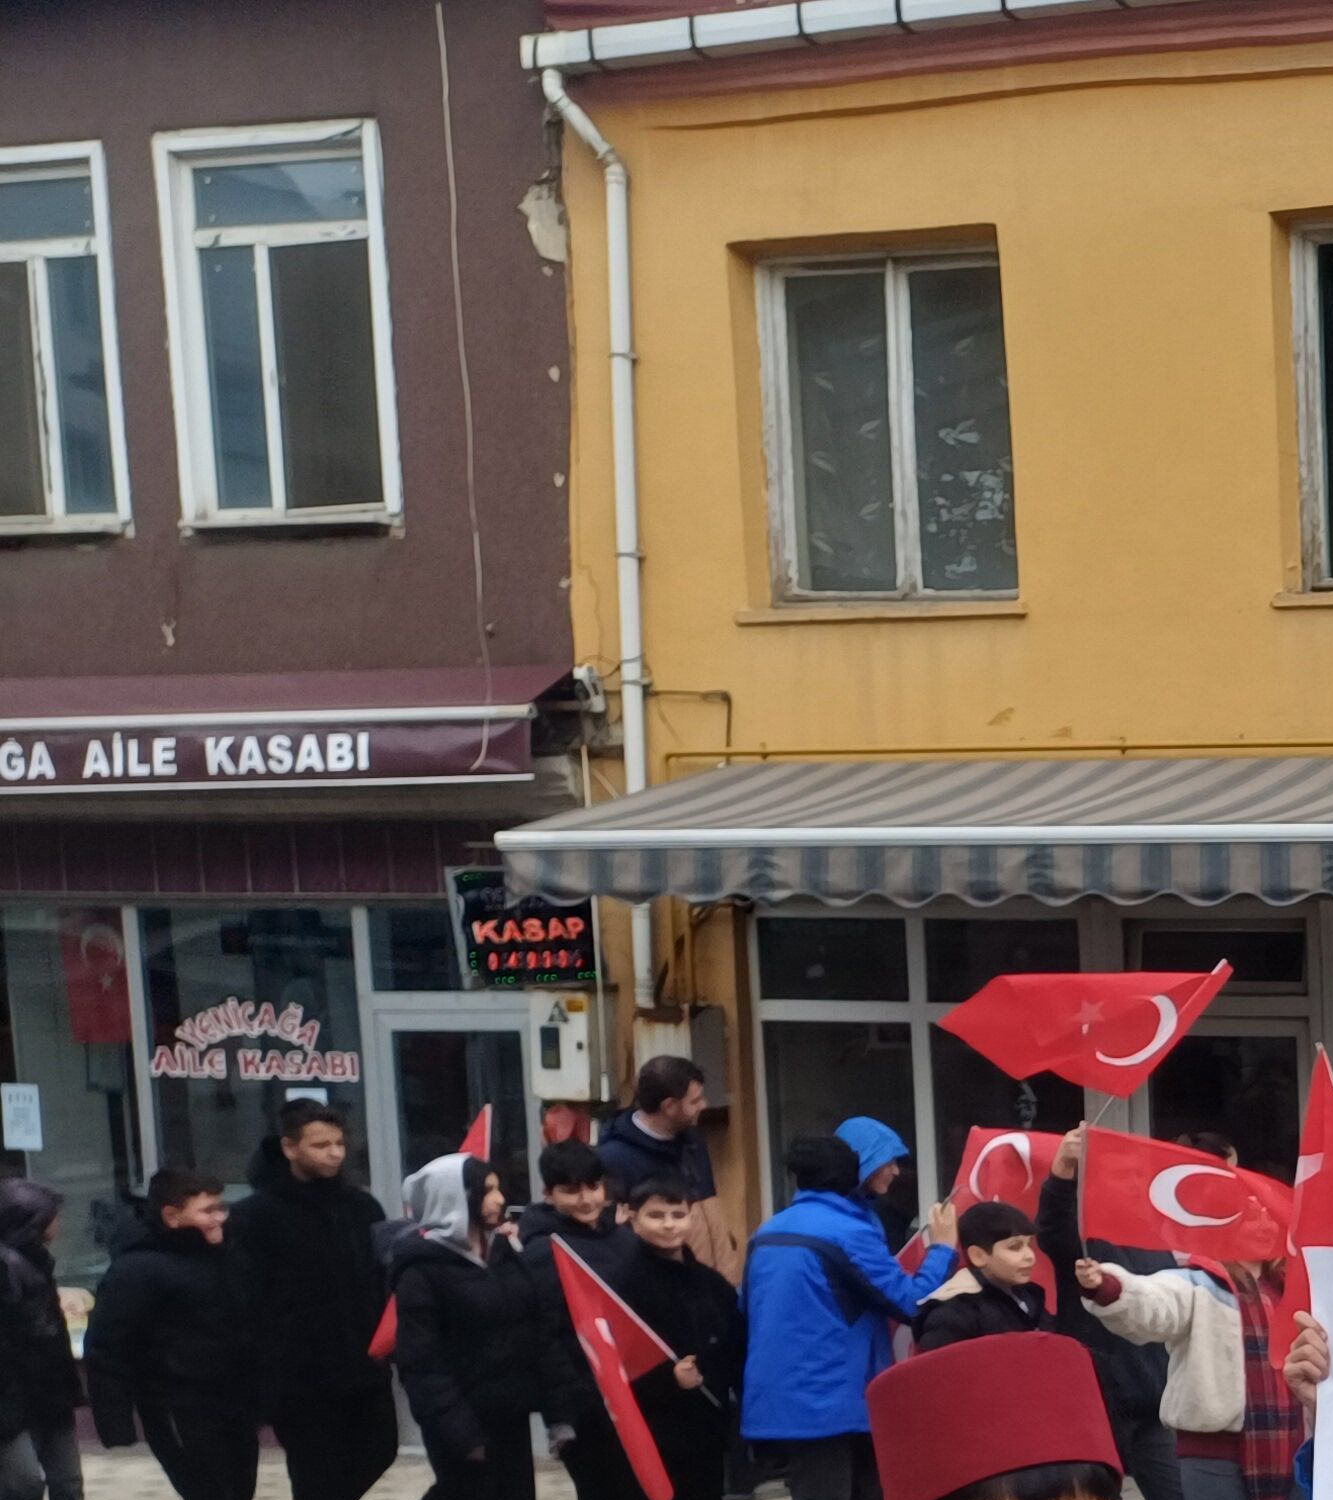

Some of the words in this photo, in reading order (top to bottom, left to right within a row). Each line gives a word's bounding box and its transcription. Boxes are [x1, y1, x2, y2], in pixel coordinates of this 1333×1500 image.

[82, 731, 178, 778] AİLE
[204, 731, 370, 776] KASABI
[175, 996, 321, 1051] YENİÇAĞA
[151, 1041, 227, 1079] AİLE
[238, 1049, 360, 1083] KASABI
